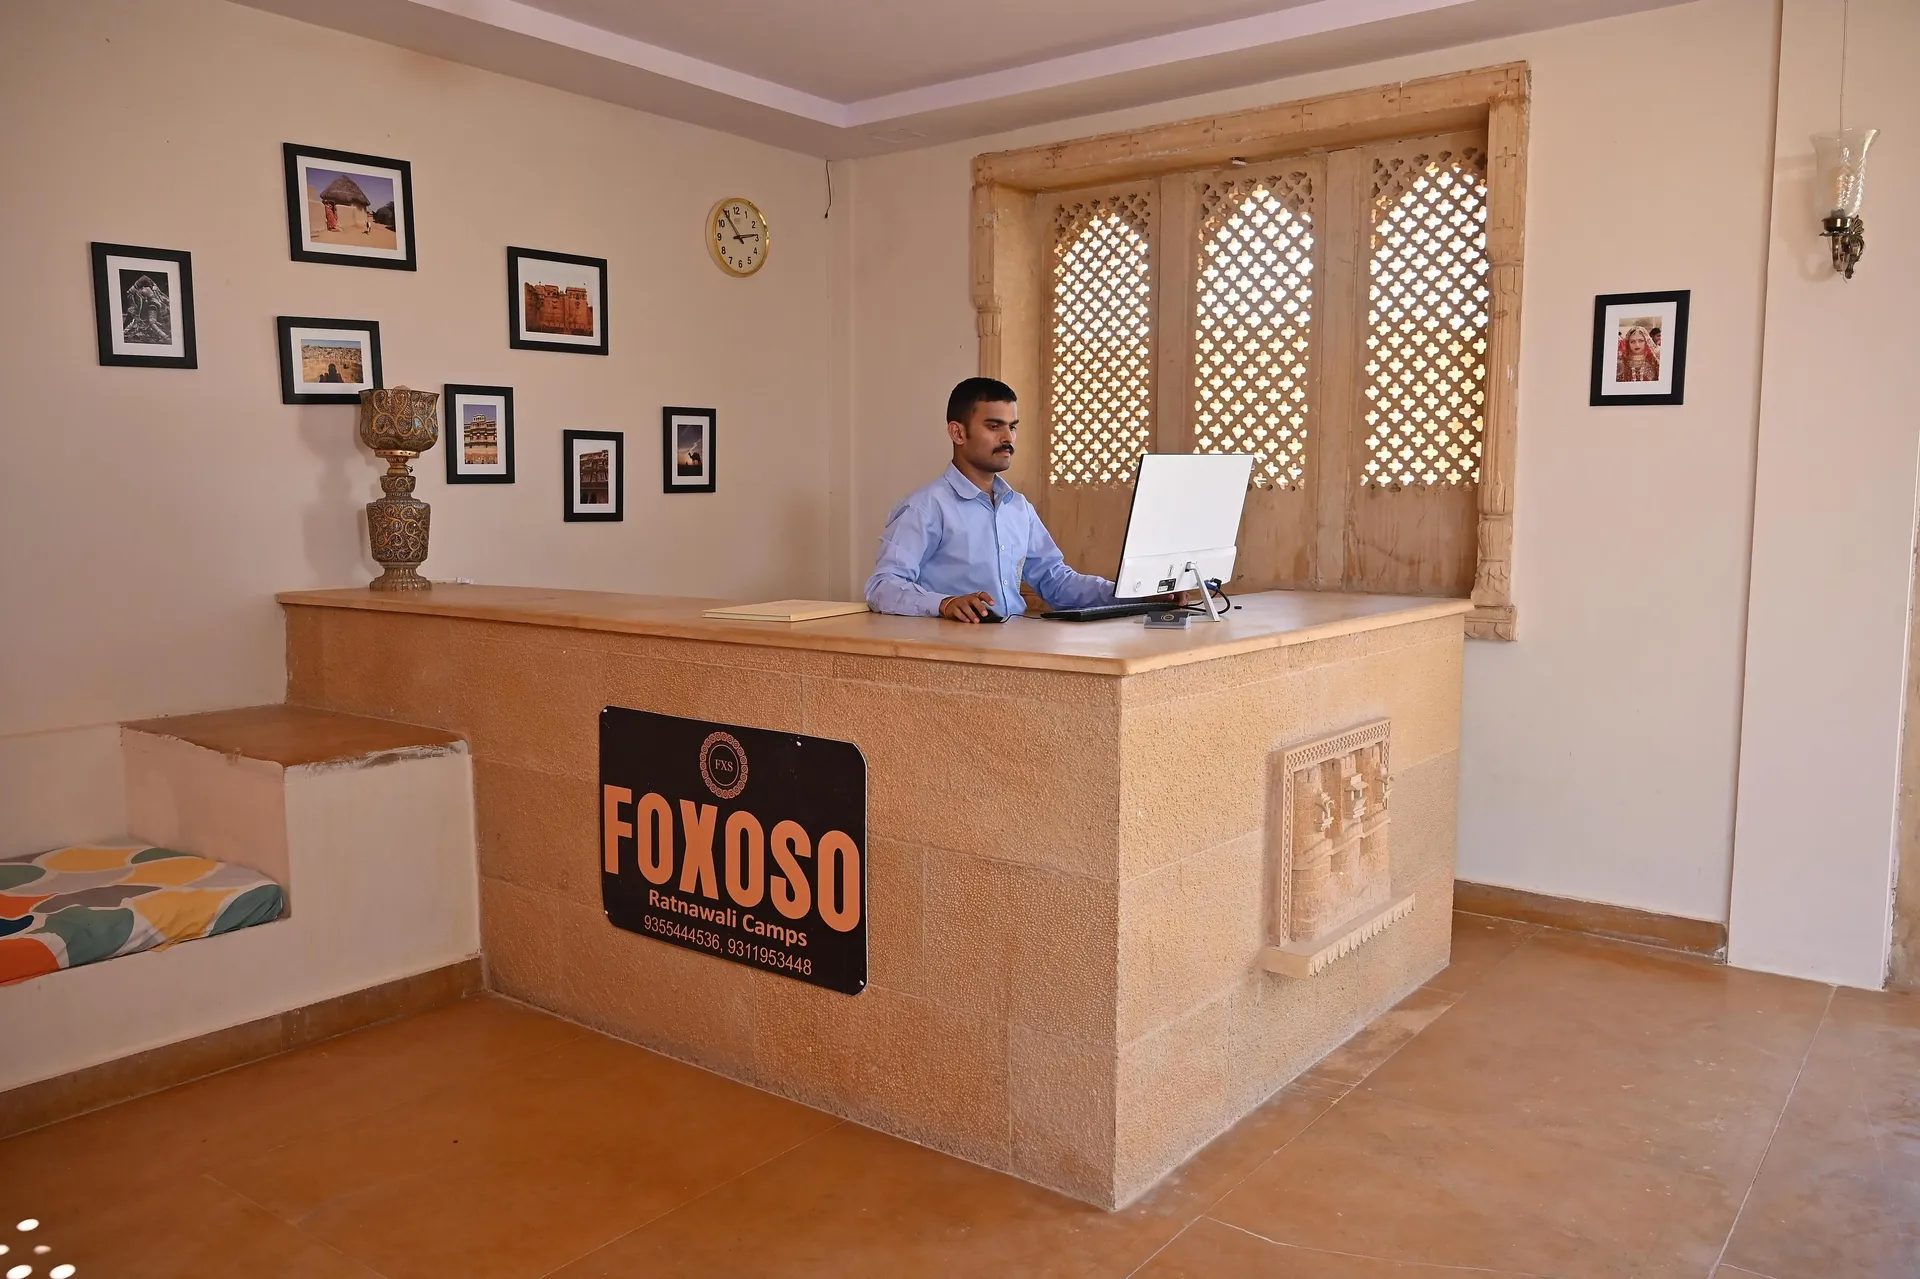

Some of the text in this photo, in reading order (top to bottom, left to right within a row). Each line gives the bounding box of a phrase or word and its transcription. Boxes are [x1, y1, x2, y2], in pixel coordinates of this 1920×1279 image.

[733, 206, 740, 215] 12
[744, 210, 748, 219] 1
[718, 219, 725, 228] 10
[751, 221, 756, 229] 2
[716, 233, 722, 241] 9
[754, 234, 760, 242] 3
[721, 246, 726, 255] 8
[753, 247, 758, 255] 4
[728, 256, 733, 265] 7
[738, 260, 743, 268] 6
[747, 257, 752, 265] 5
[715, 759, 734, 772] FXS
[604, 784, 861, 933] FOXOSO
[649, 889, 808, 947] Ratnawali Camps
[644, 915, 812, 976] 9355444536, 9311953448
